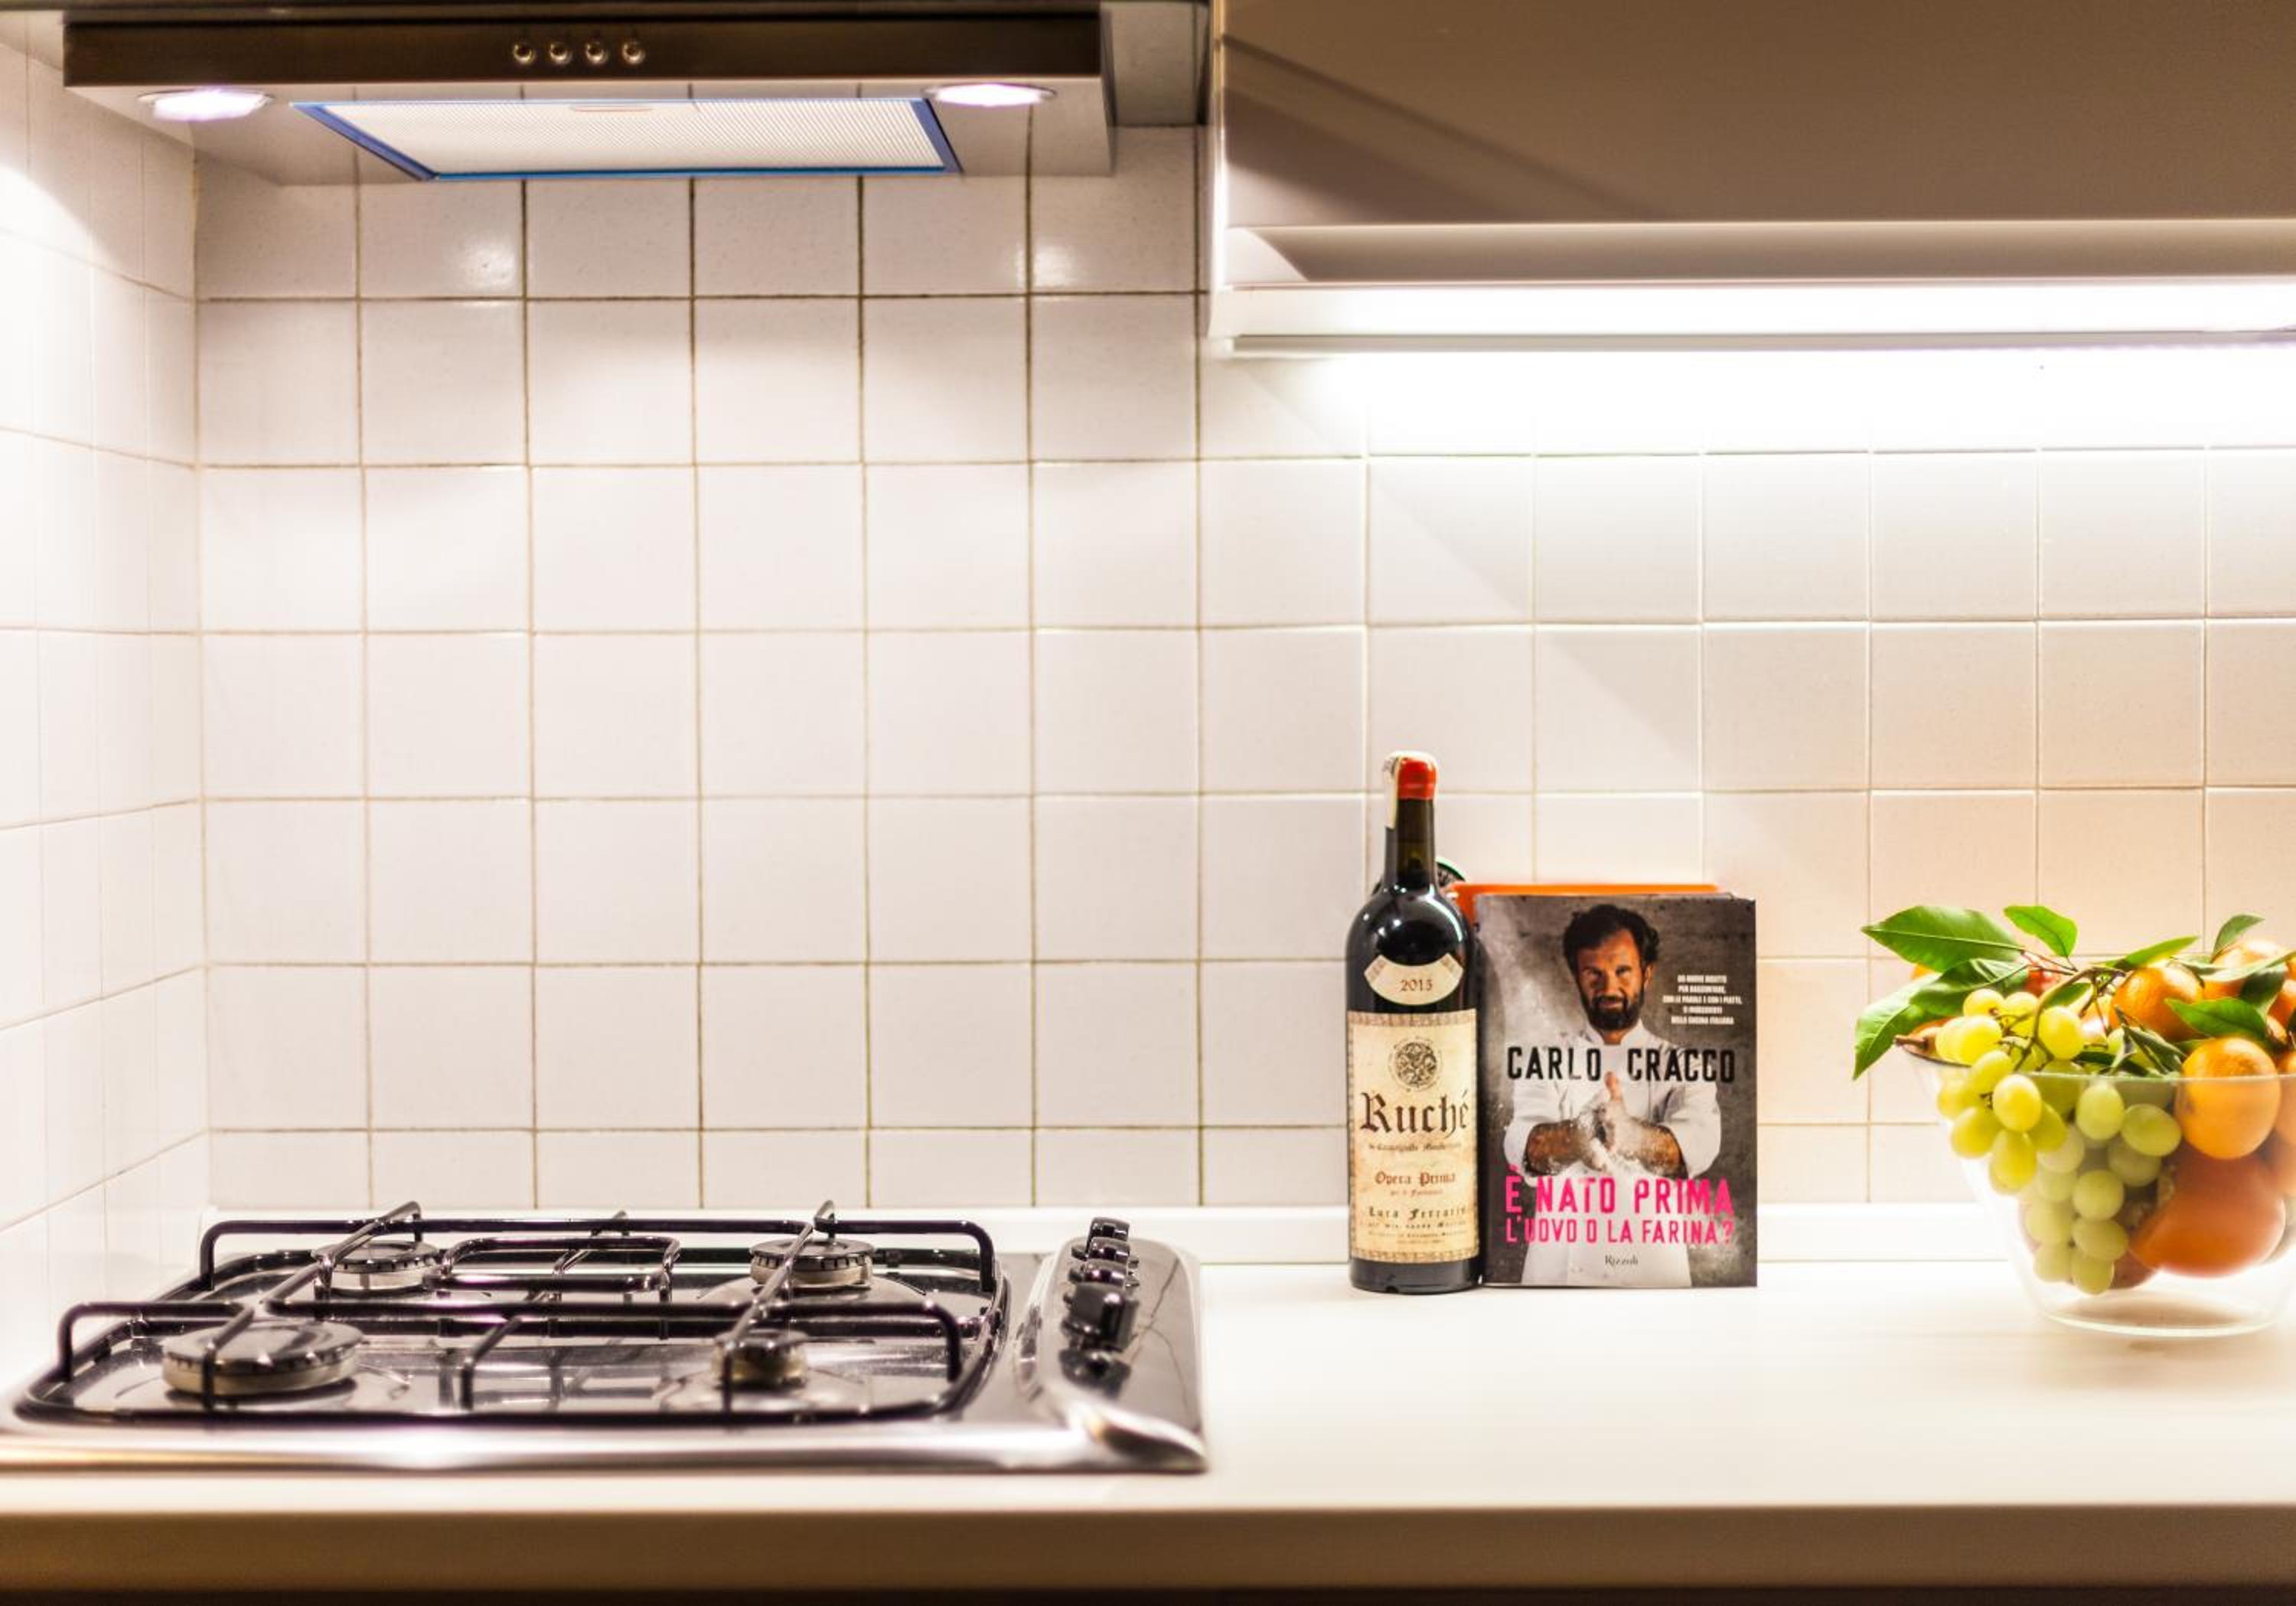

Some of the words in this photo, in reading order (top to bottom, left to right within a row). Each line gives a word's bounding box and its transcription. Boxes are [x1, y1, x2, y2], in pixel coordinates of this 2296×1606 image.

[1507, 1046, 1602, 1081] CARLO
[1627, 1048, 1736, 1084] CRACCO
[1360, 1089, 1469, 1139] Ruché
[1505, 1164, 1522, 1213] È
[1535, 1175, 1616, 1213] NATO
[1634, 1176, 1735, 1215] PRIMA
[1505, 1218, 1577, 1243] L'UOVO
[1586, 1219, 1598, 1244] O
[1606, 1219, 1633, 1244] LA
